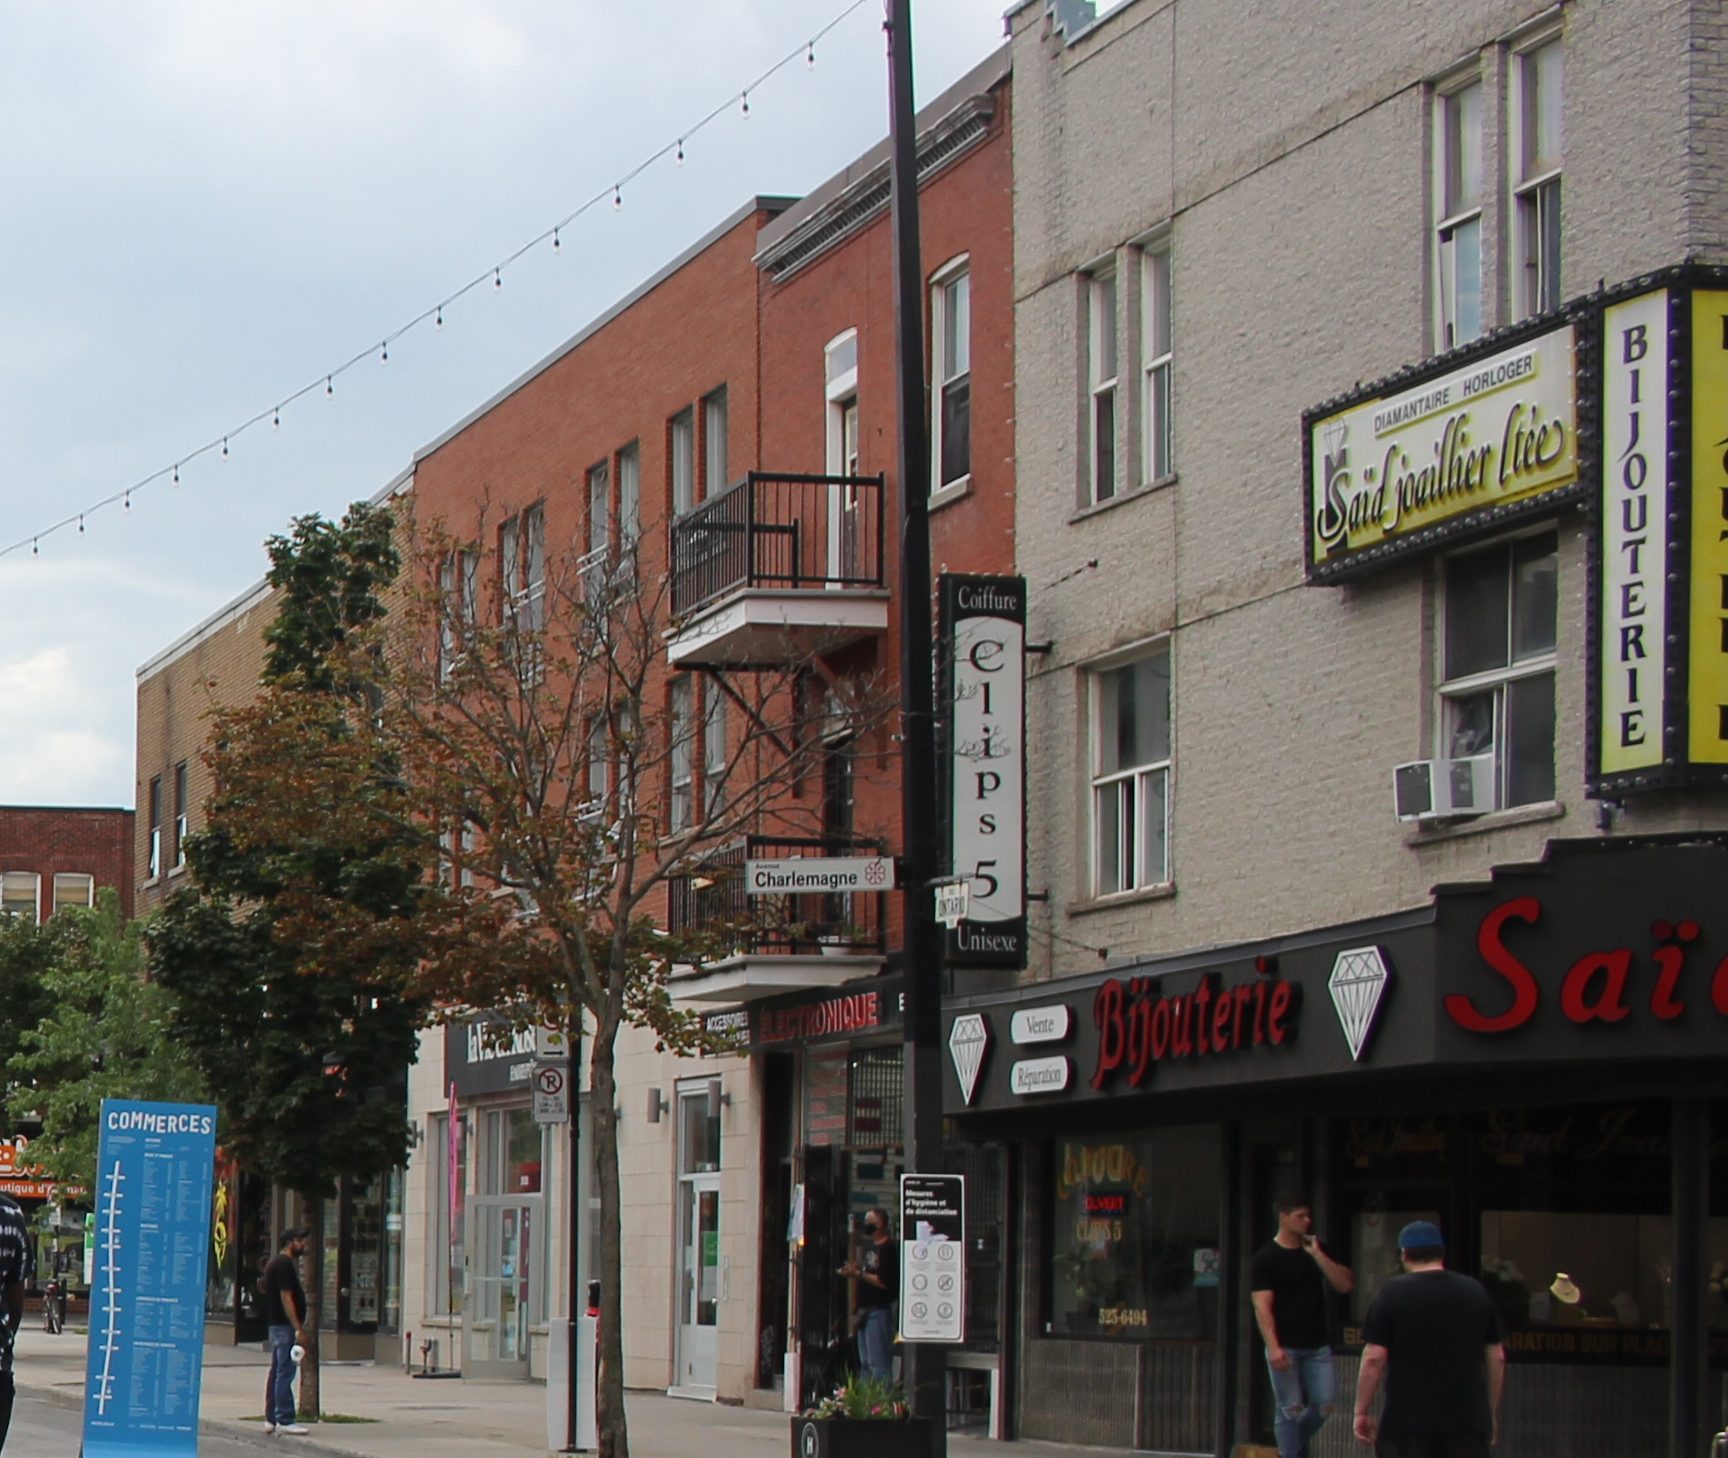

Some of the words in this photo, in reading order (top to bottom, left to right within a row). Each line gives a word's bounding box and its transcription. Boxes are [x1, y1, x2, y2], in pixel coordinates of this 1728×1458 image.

[1374, 386, 1450, 433] DIAMANTAIRE
[1462, 354, 1533, 397] HORLOGER
[1617, 324, 1648, 748] BIJOUTERIE
[957, 585, 1018, 611] Coiffure
[969, 638, 1005, 834] Clips
[755, 871, 858, 888] Charlemagne
[972, 859, 998, 899] 5
[957, 925, 1018, 953] Unisexe
[1444, 896, 1728, 1033] Saï
[1025, 1015, 1055, 1035] Vente
[1090, 955, 1294, 1091] Bijouterie
[1017, 1062, 1062, 1093] Réparation
[108, 1110, 212, 1135] COMMERCES
